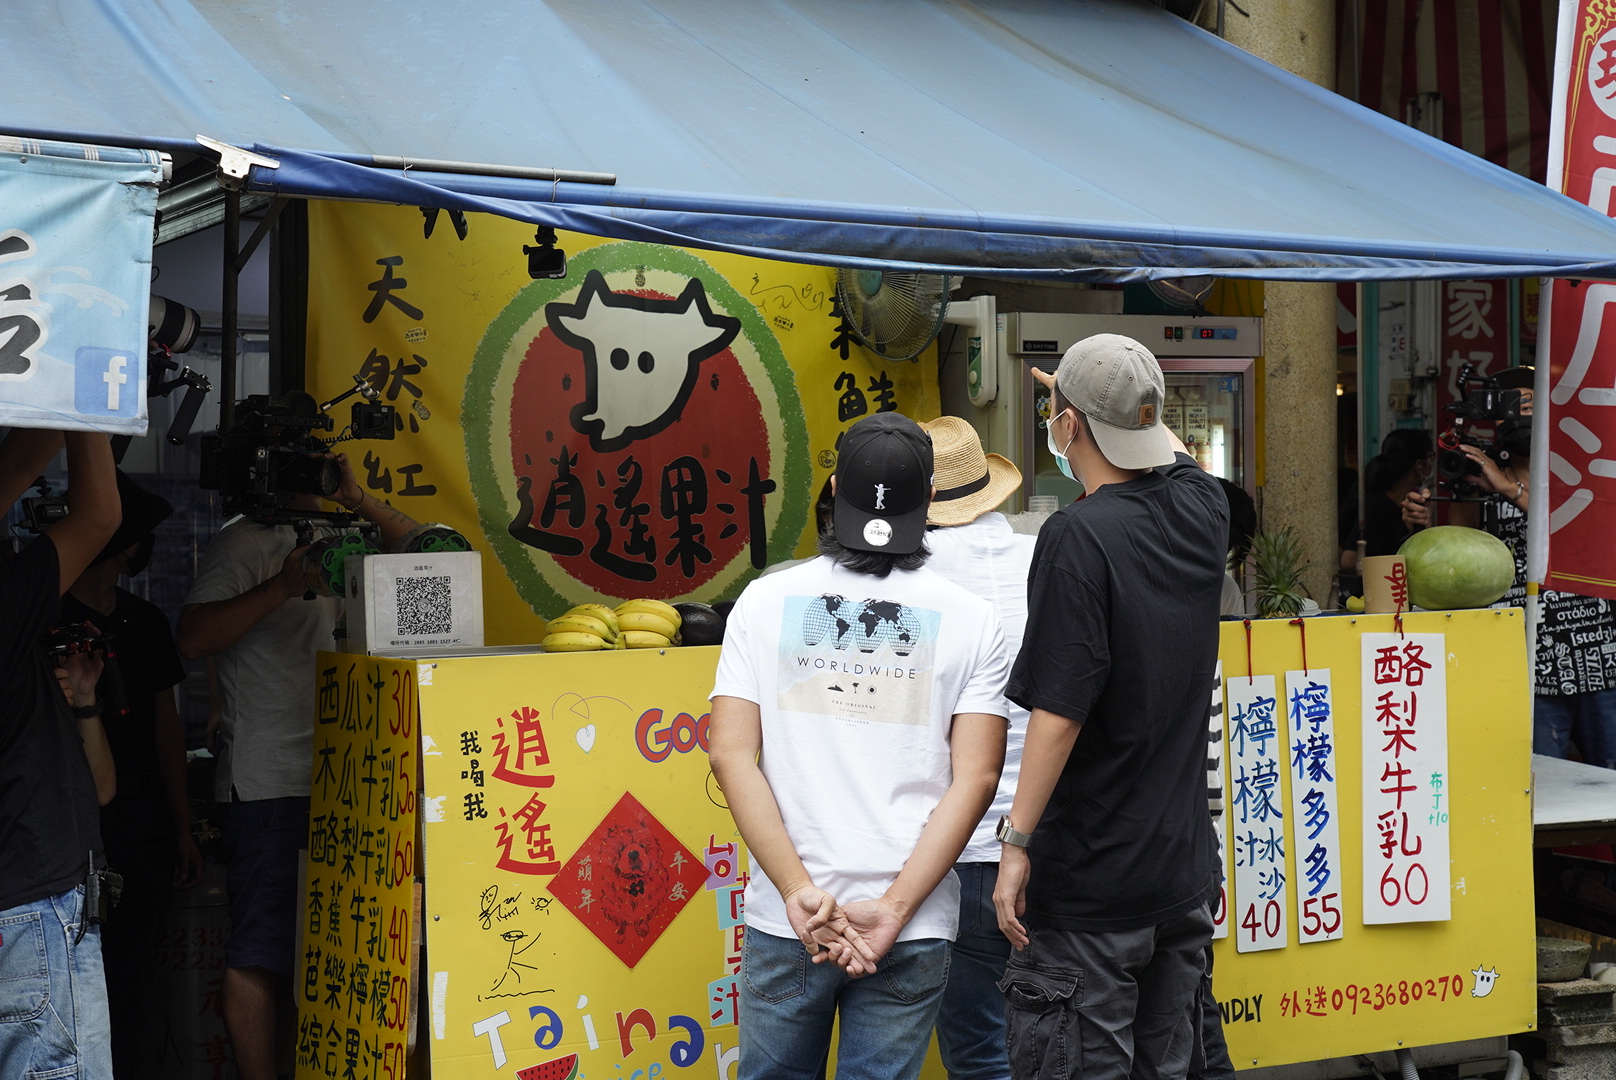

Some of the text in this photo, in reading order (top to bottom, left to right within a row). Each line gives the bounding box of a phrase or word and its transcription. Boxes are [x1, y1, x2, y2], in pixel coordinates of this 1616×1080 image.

[508, 444, 777, 582] 逍遙果汁
[319, 663, 412, 740] 西瓜汁 30
[797, 656, 916, 680] WORLDWIDE
[846, 702, 876, 710] ORIGINAL
[315, 737, 414, 821] 木瓜牛乳 50
[460, 730, 488, 821] 我喝我
[1290, 681, 1334, 897] 檸檬多多
[1374, 641, 1432, 860] 酪梨牛乳
[491, 706, 562, 876] 逍遙
[311, 810, 413, 890] 酪梨牛乳 60
[668, 850, 689, 901] 平安
[1380, 863, 1429, 907] 60
[308, 877, 387, 962] 香蕉牛乳
[389, 905, 408, 966] 40
[1241, 900, 1281, 942] 40
[1303, 893, 1341, 938] 55
[388, 975, 408, 1031] 50
